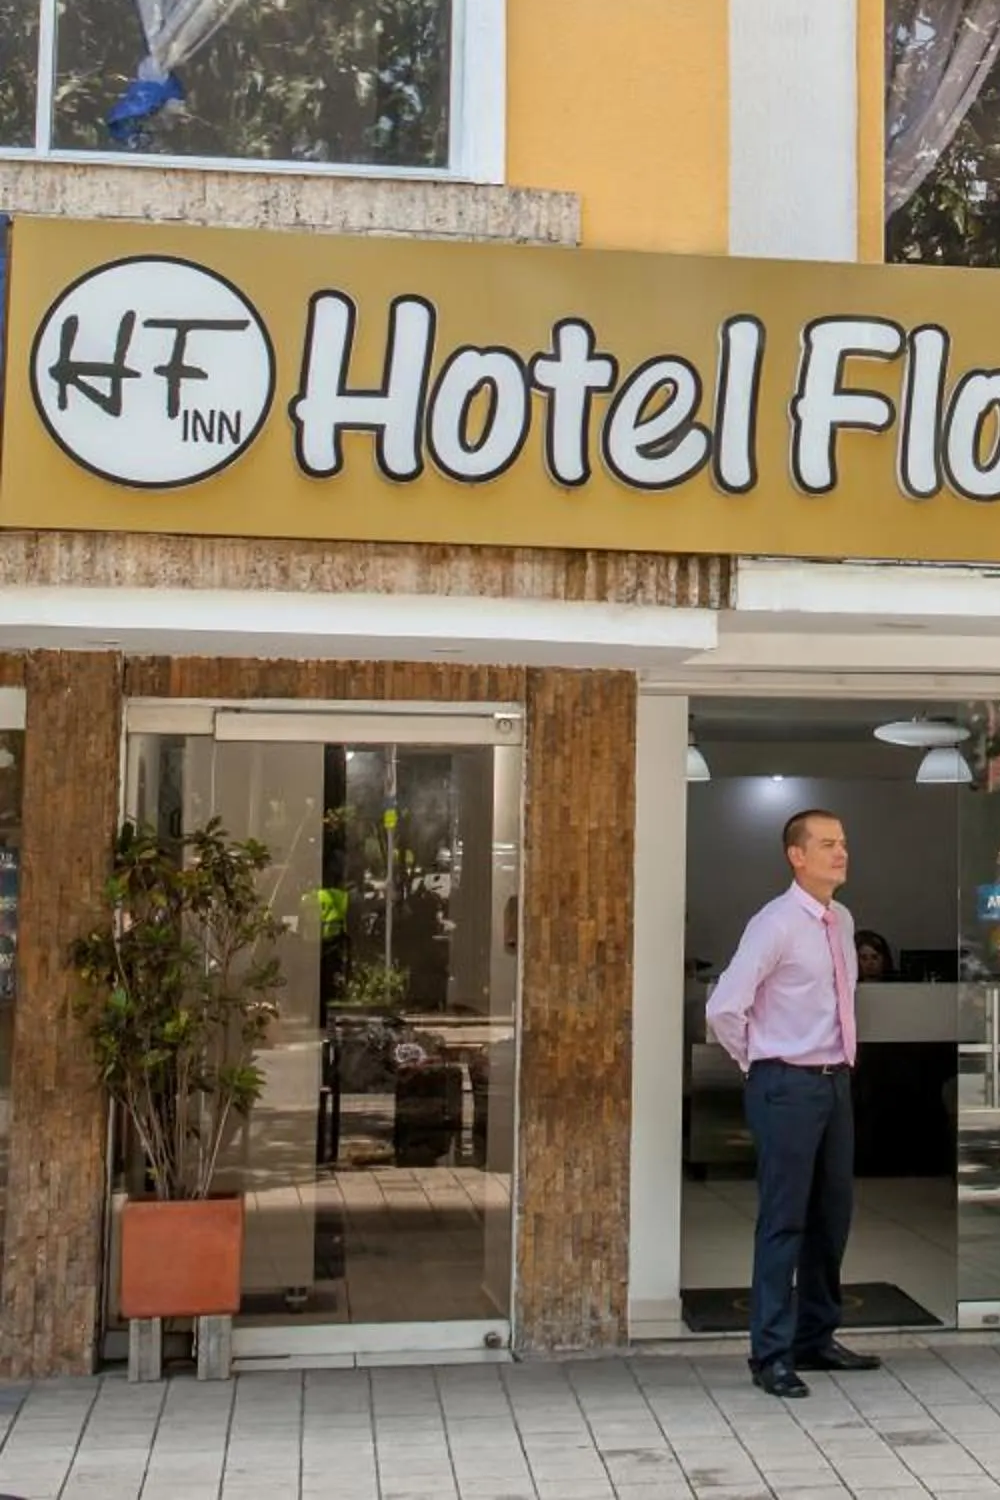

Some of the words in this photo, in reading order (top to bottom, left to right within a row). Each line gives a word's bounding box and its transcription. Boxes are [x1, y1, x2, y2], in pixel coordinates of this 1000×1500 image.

[48, 309, 251, 418] HF
[288, 288, 767, 494] Hotel
[182, 408, 242, 445] INN
